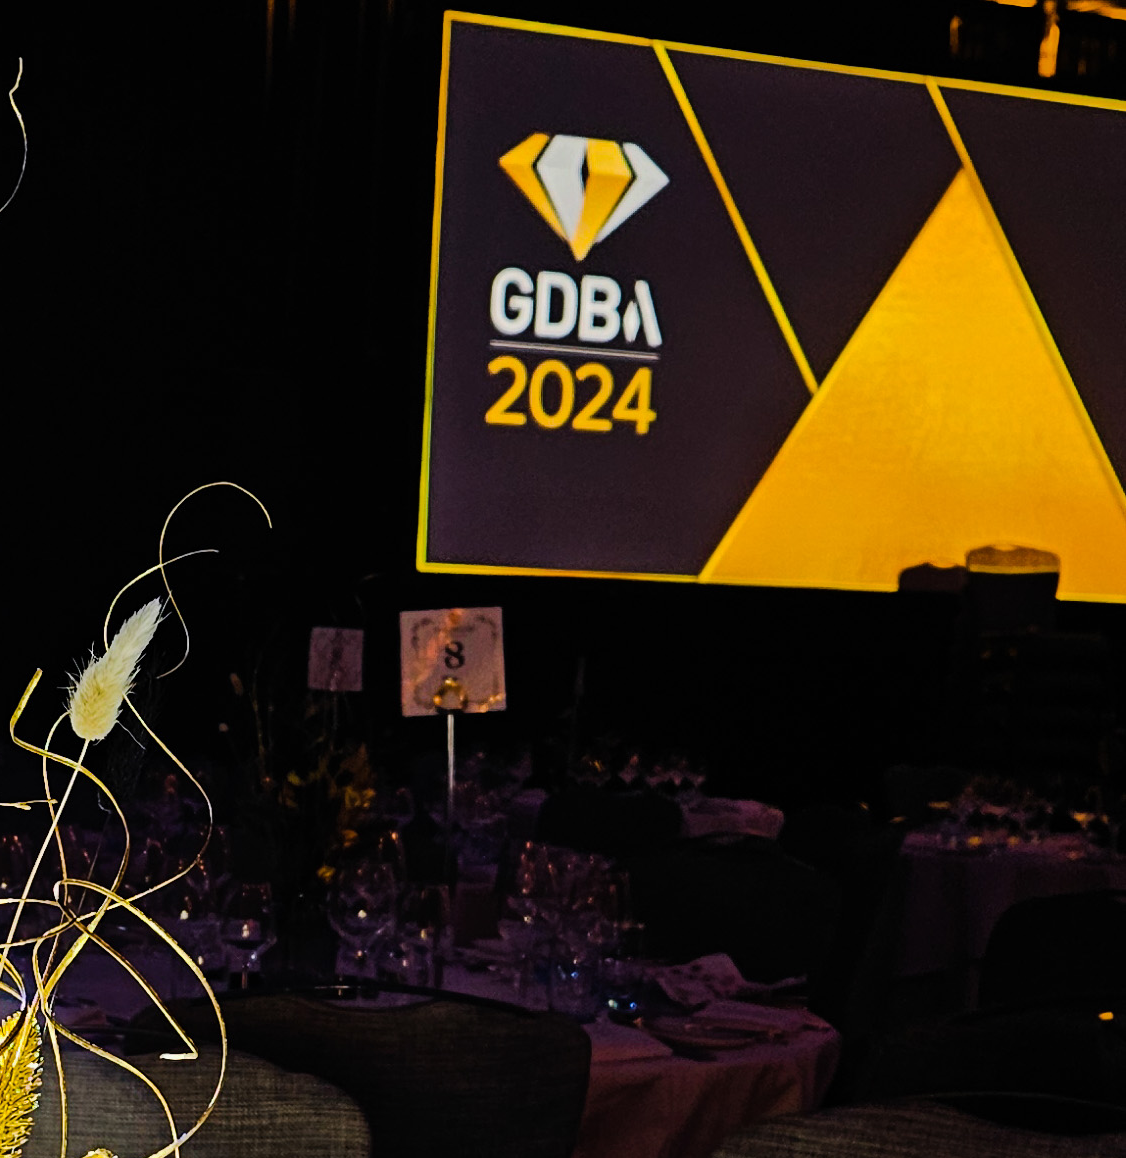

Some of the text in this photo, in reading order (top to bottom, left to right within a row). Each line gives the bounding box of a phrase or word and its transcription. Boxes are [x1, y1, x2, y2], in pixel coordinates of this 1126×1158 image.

[490, 267, 663, 347] GDBA
[485, 355, 657, 434] 2024
[444, 641, 464, 669] 8
